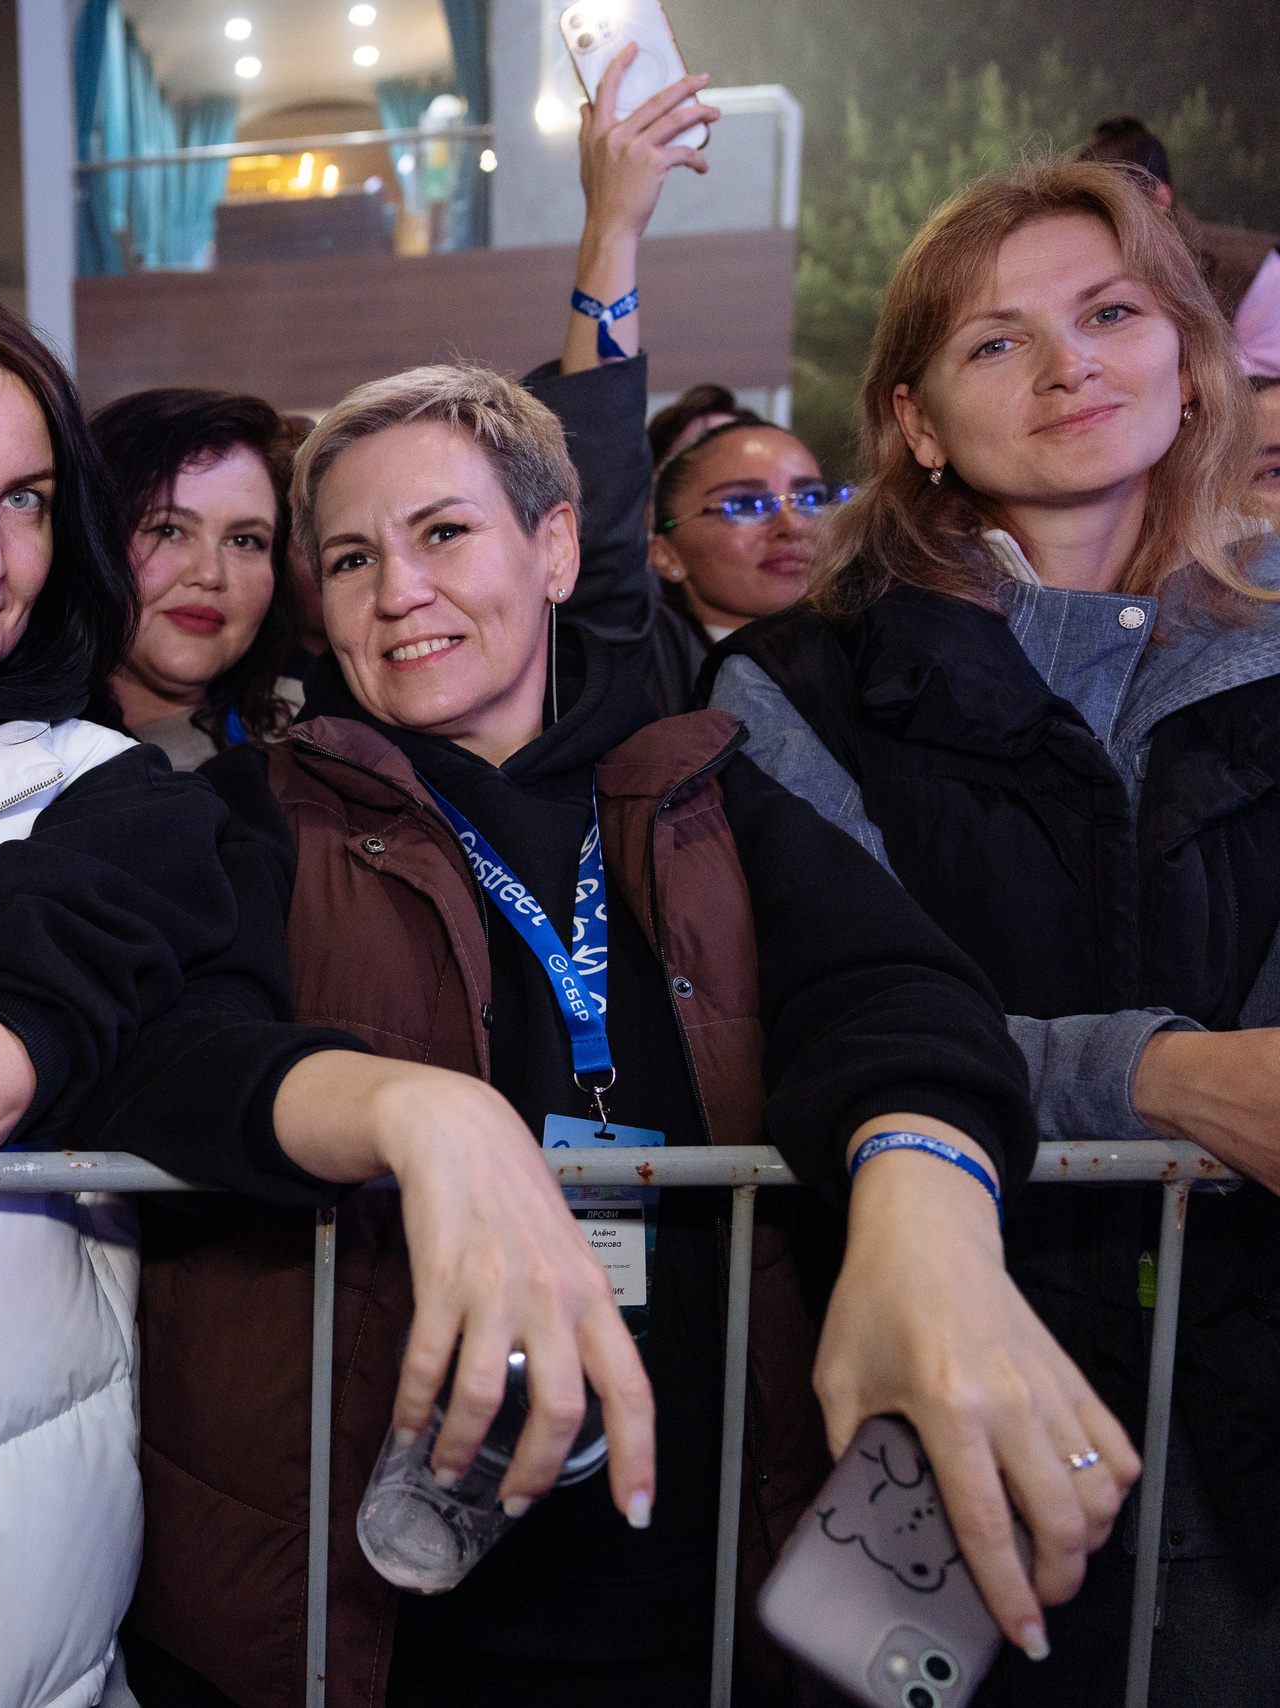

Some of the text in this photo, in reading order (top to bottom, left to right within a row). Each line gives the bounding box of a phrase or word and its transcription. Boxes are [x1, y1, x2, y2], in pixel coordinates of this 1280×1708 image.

[561, 976, 590, 1022] СБЕР
[586, 1210, 619, 1219] ПРОФИ
[591, 1228, 617, 1237] Алёна
